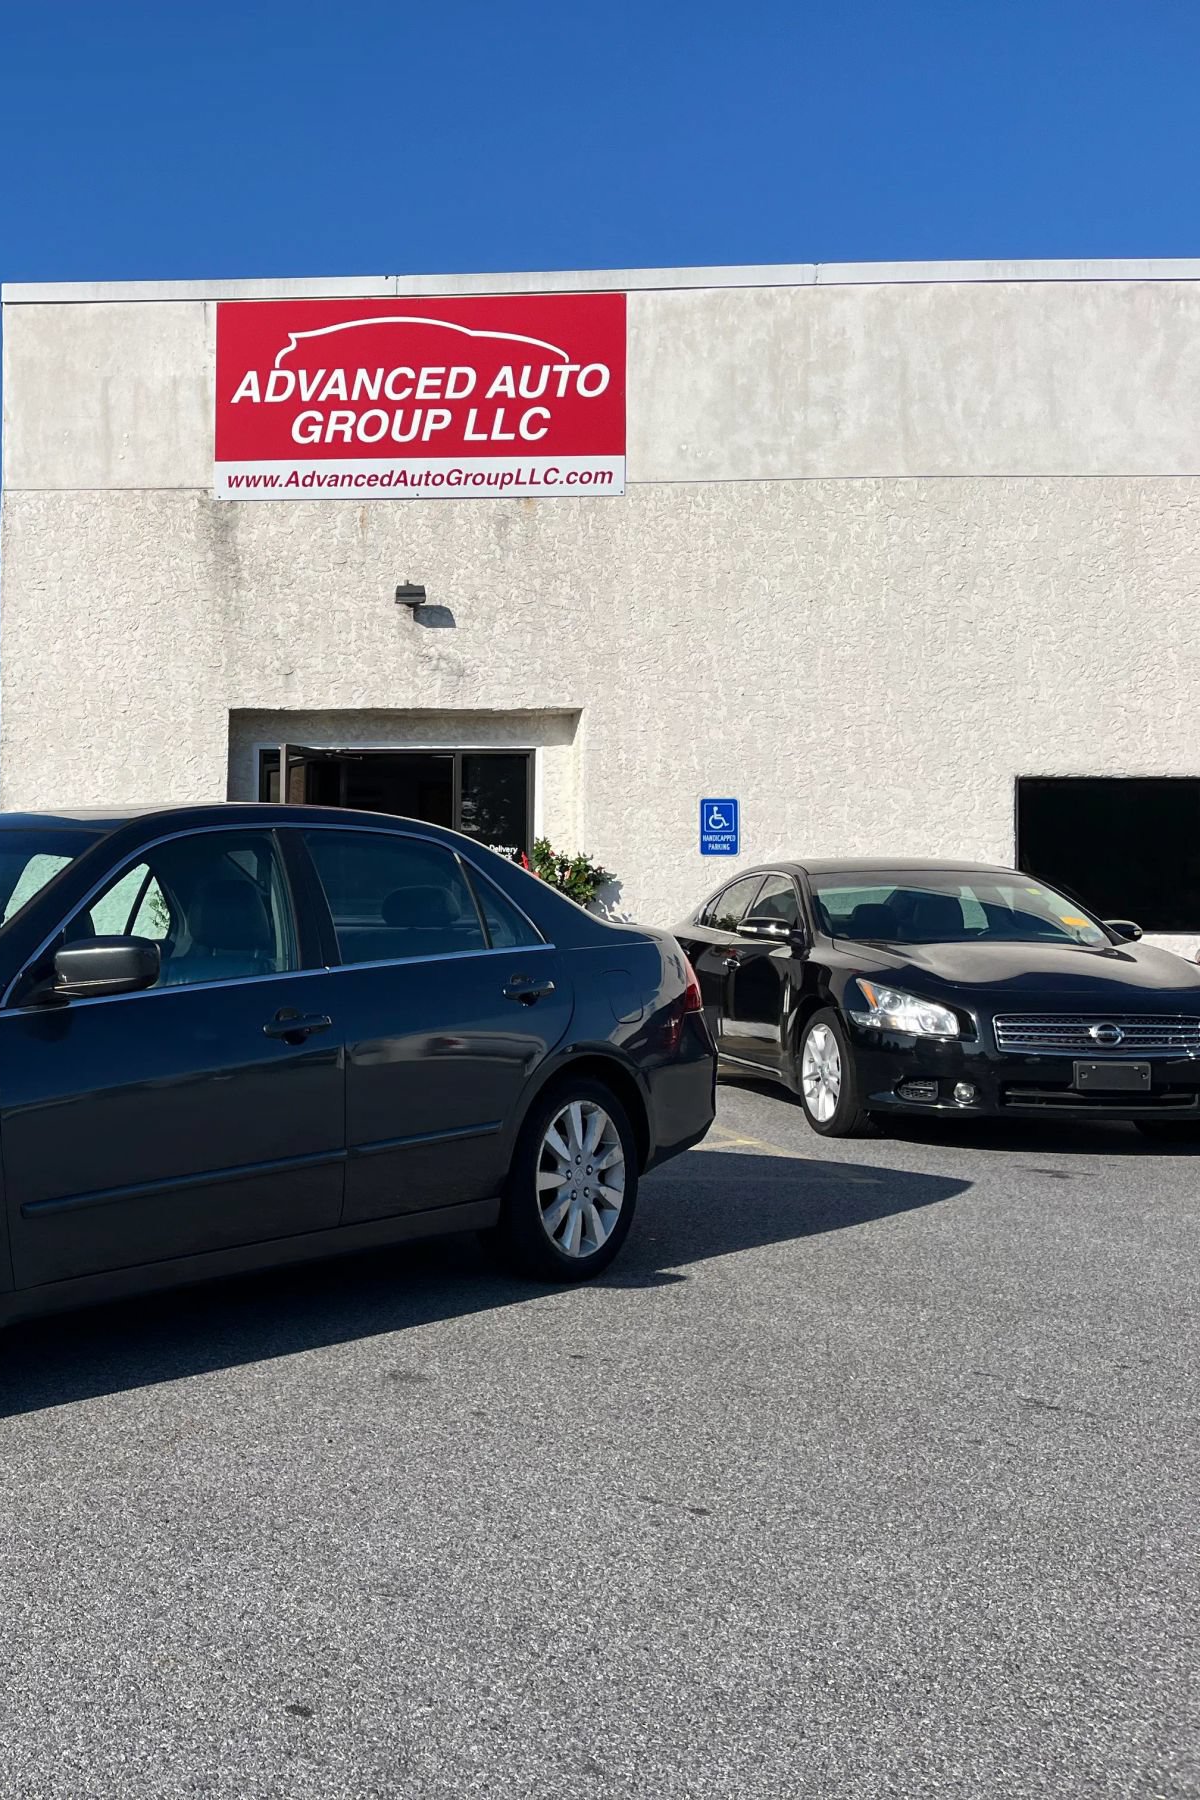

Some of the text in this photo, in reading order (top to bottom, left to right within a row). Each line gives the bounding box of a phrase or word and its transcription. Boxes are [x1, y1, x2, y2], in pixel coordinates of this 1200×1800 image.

[231, 364, 610, 403] ADVANCED AUTO
[292, 407, 550, 444] GROUP LLC
[228, 468, 613, 491] www.AdvancedAutoGroupLLC.com
[702, 834, 736, 842] HANDICAPPED
[489, 844, 518, 855] Delivery
[708, 843, 731, 851] PARKING
